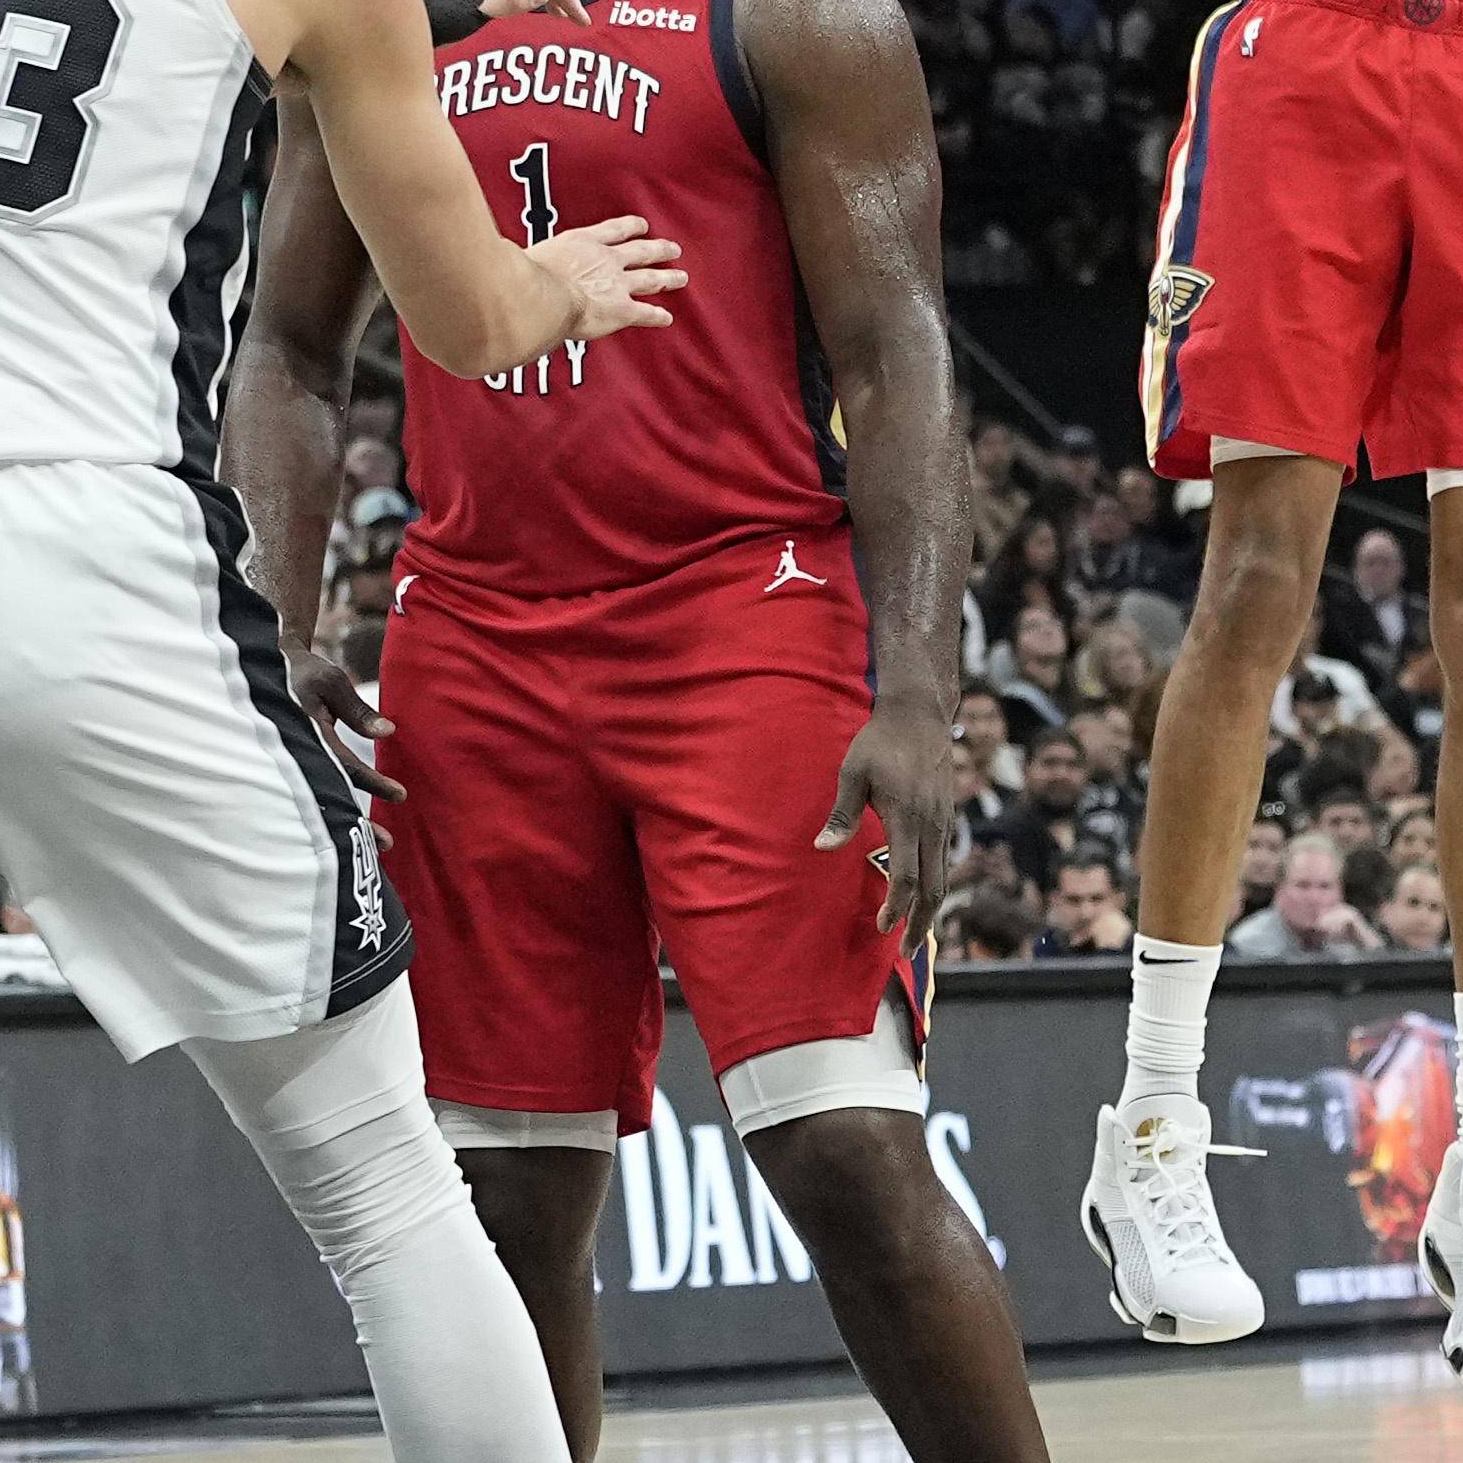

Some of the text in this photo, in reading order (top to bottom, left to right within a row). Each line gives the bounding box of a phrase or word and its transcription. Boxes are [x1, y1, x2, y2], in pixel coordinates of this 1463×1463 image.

[609, 1, 697, 32] ibotta
[434, 45, 661, 134] RESCENT
[509, 142, 558, 249] 1
